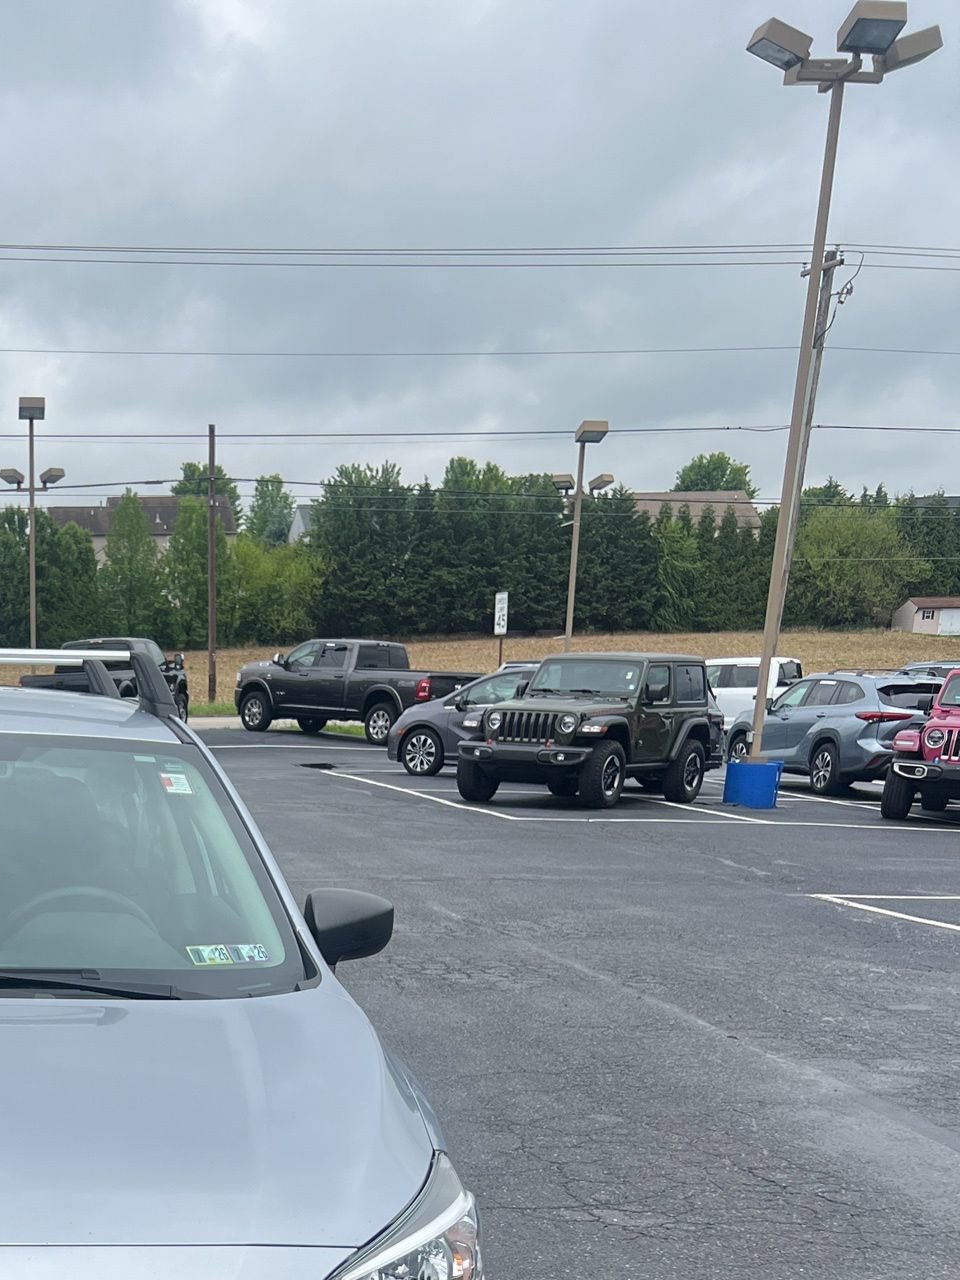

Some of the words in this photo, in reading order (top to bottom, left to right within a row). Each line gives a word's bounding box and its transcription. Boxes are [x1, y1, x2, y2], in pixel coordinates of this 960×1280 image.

[496, 613, 506, 629] 45
[214, 947, 229, 961] 26
[253, 945, 268, 959] 26
